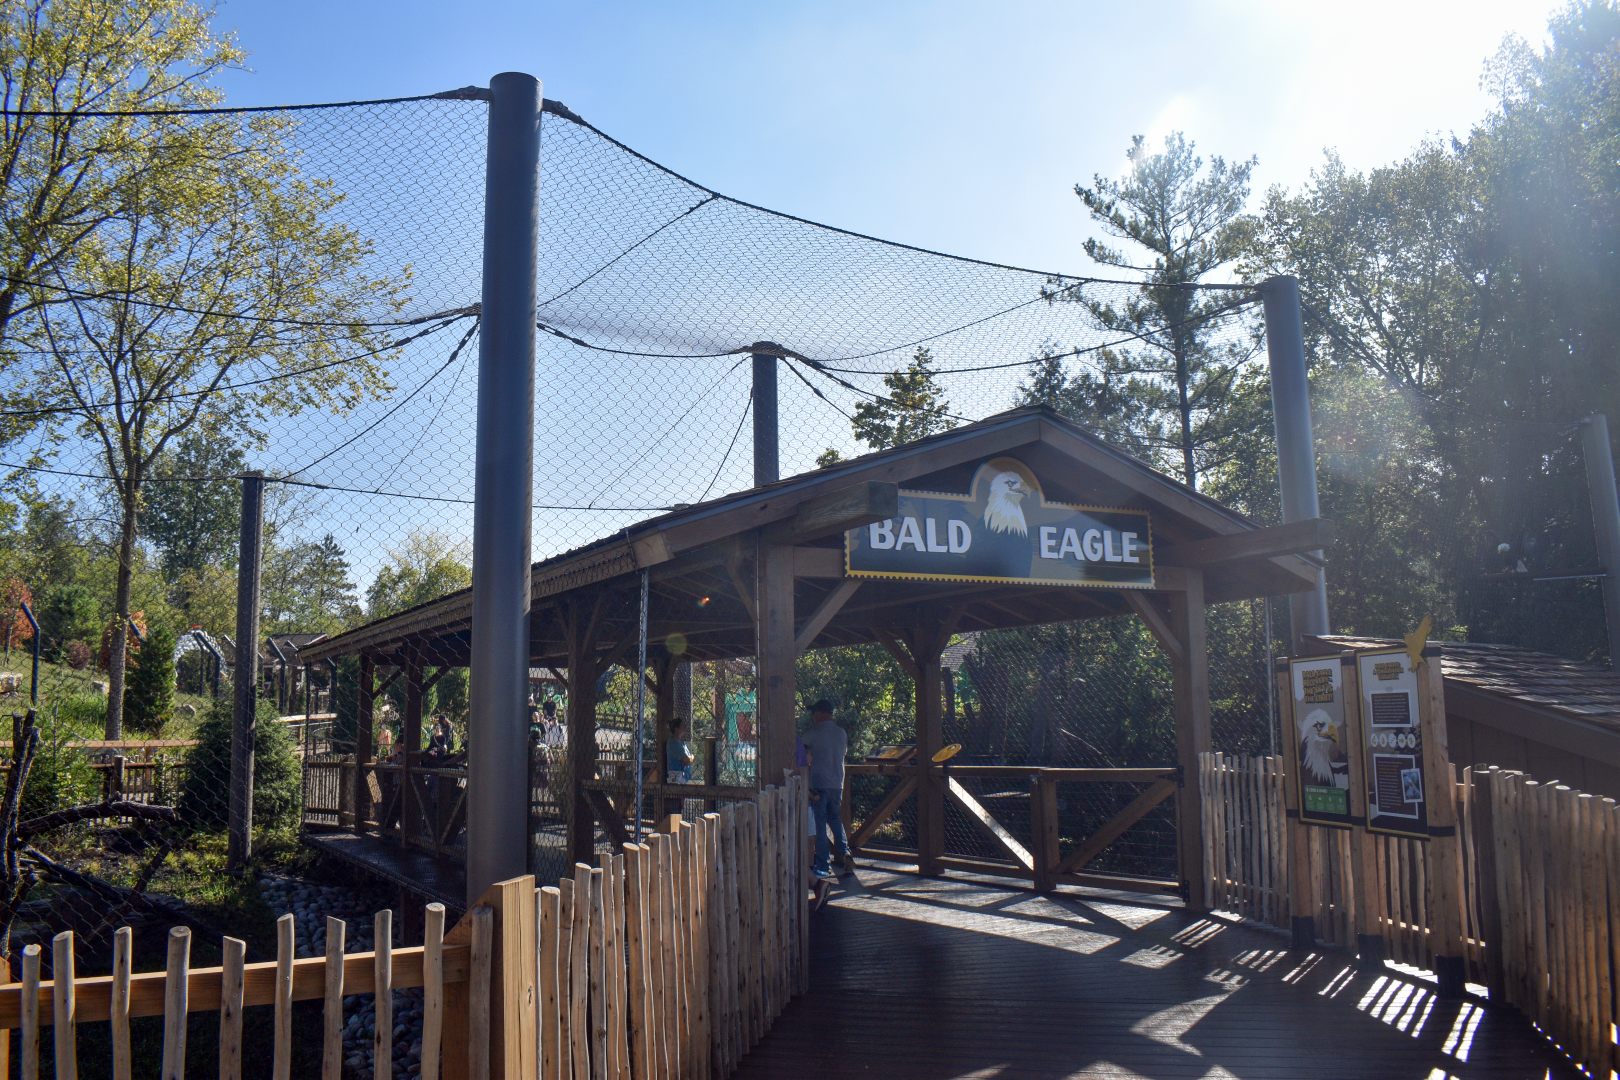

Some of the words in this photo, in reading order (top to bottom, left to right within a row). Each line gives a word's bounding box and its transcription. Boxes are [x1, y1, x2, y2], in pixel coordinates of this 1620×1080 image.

[868, 517, 972, 555] BALD
[1039, 526, 1140, 564] EAGLE
[1302, 670, 1316, 679] BALD
[1316, 669, 1332, 677] EAGLE
[1303, 687, 1315, 696] THE
[1315, 685, 1326, 695] SKY
[1327, 684, 1333, 694] IS
[1304, 695, 1315, 704] THE
